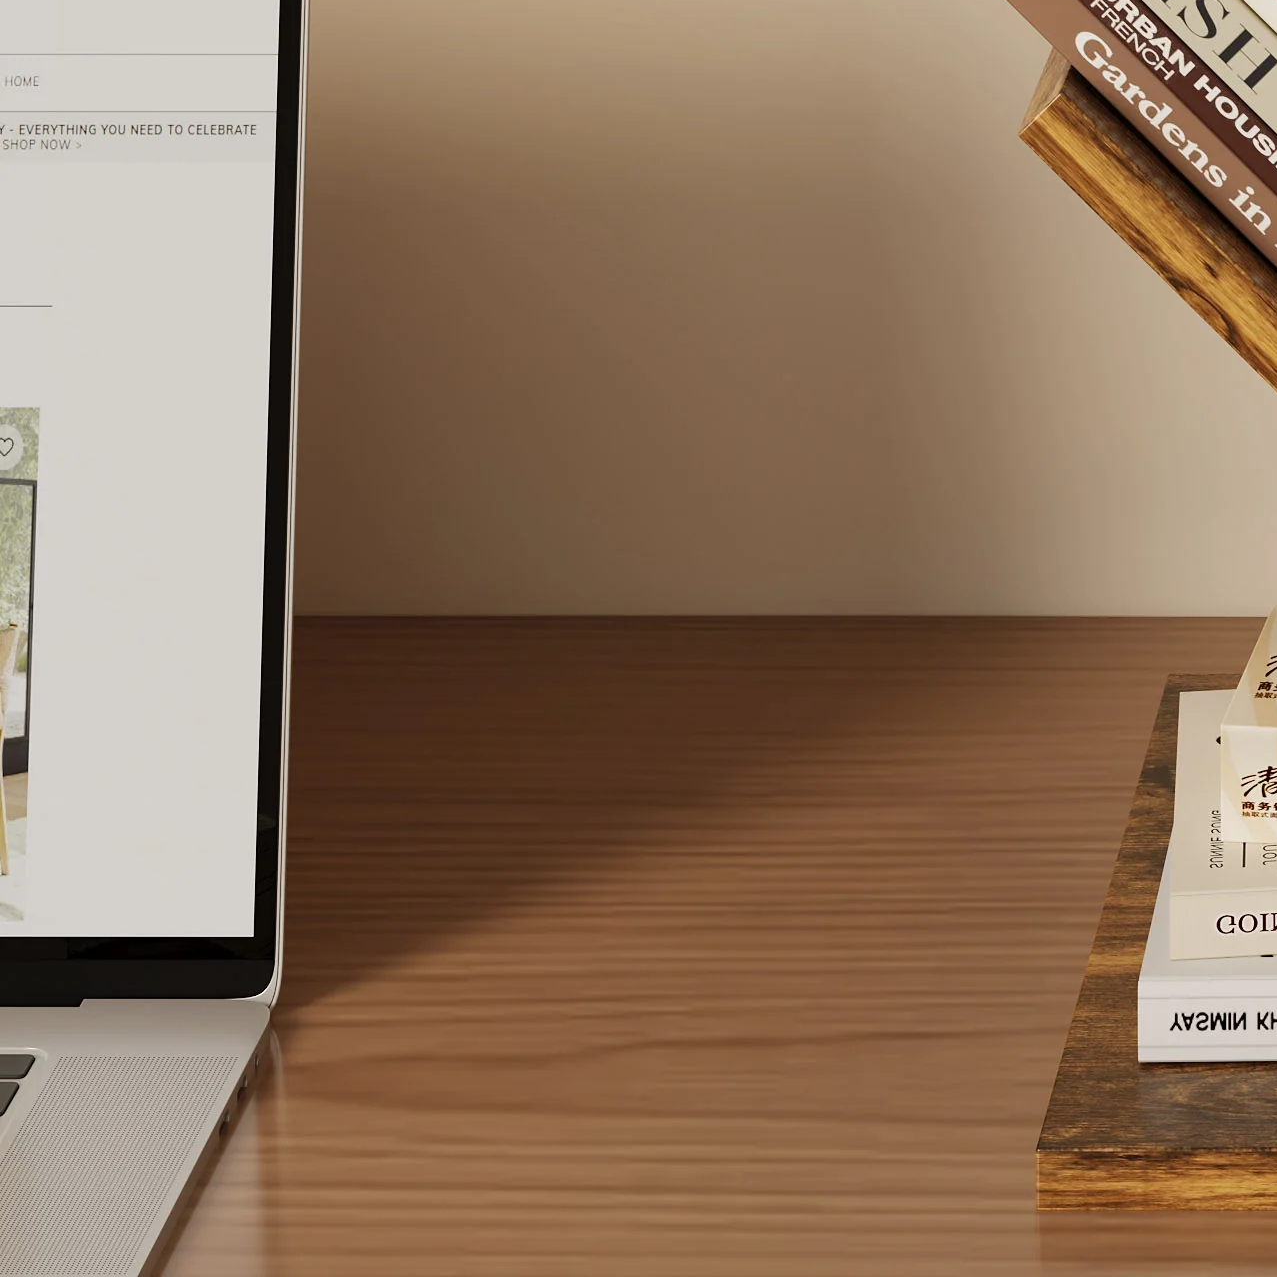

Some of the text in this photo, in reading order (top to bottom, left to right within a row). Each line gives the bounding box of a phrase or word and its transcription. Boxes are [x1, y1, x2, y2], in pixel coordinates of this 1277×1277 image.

[4, 76, 40, 87] HOME
[19, 124, 257, 136] EVERYTHING YOU NEED TO CELEBRATE
[1074, 32, 1227, 188] Gardens
[1224, 187, 1271, 236] in
[2, 139, 71, 151] SHOP NOW
